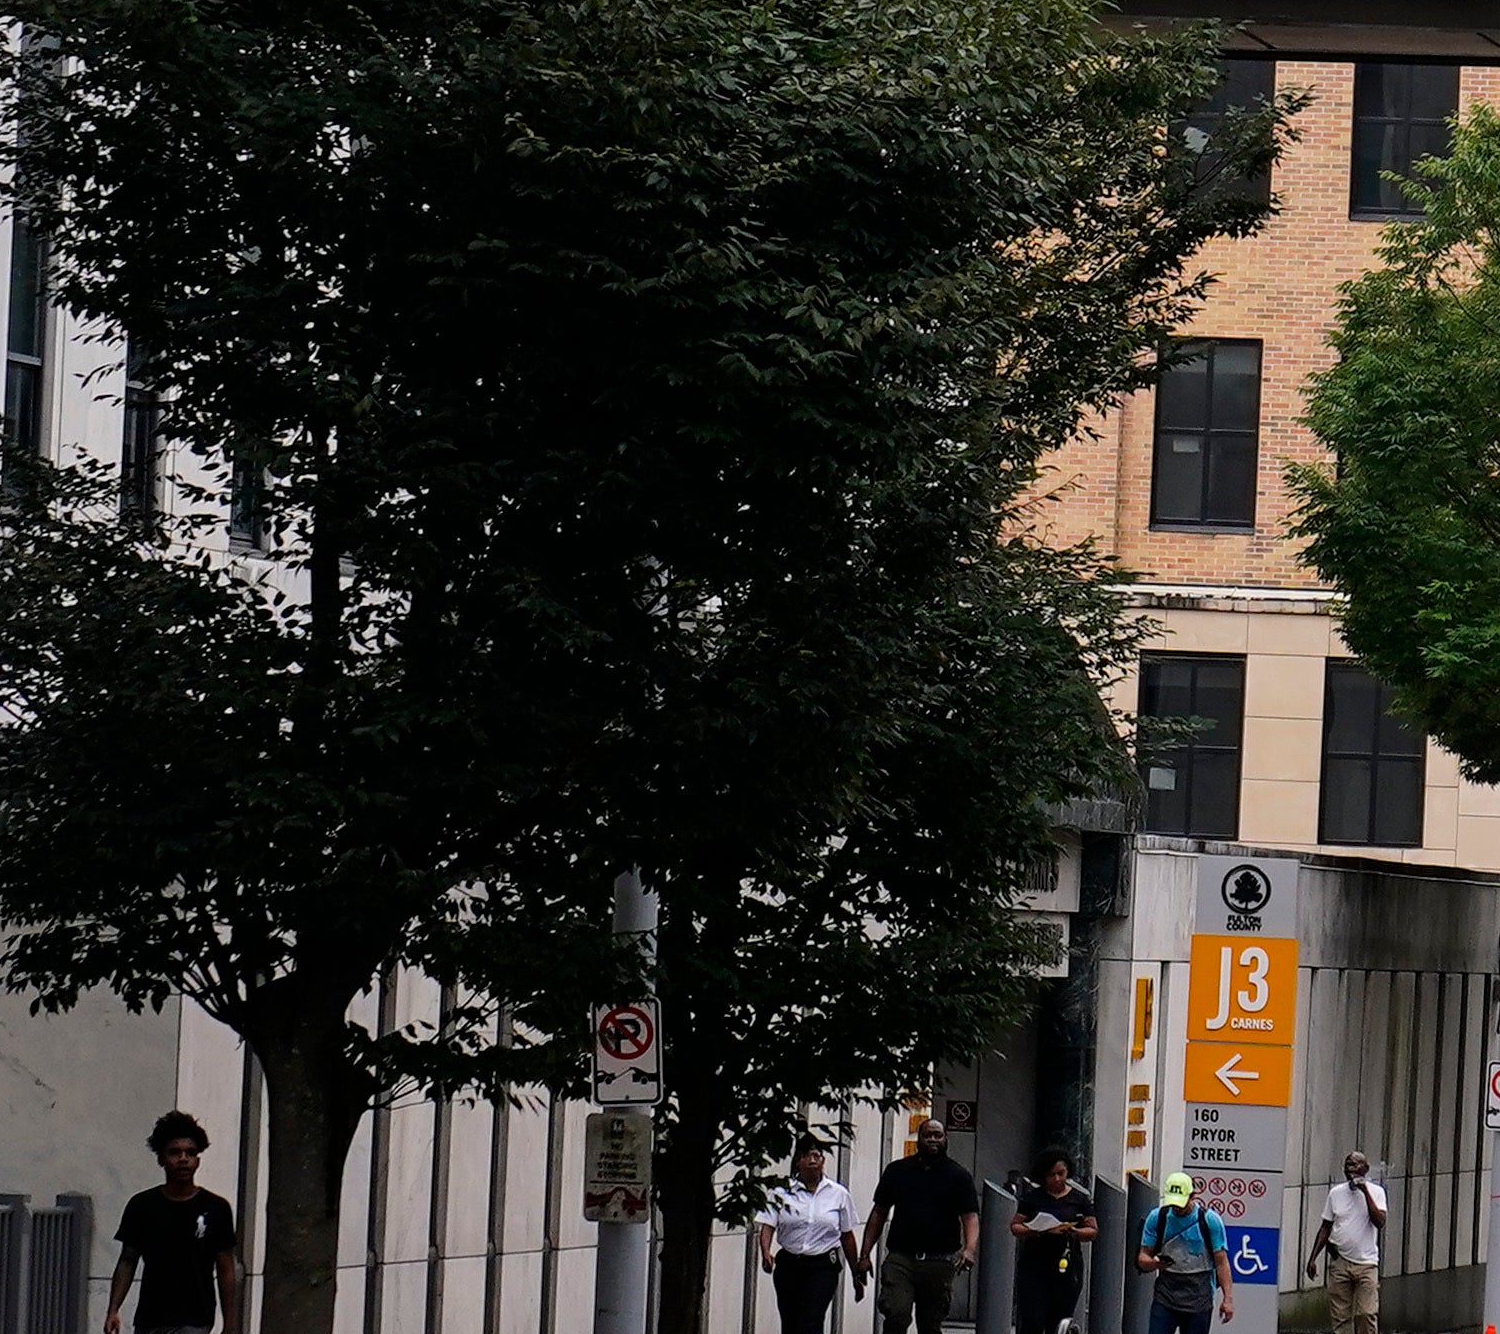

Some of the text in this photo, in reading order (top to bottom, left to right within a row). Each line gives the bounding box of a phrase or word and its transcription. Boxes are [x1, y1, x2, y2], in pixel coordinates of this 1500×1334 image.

[1226, 922, 1263, 932] COUNTY
[1227, 914, 1262, 925] FULTON
[1206, 946, 1270, 1031] J3
[1230, 1017, 1274, 1031] CARNES
[1194, 1108, 1219, 1123] 160
[1191, 1127, 1236, 1144] PRYOR
[1190, 1146, 1241, 1163] STREET
